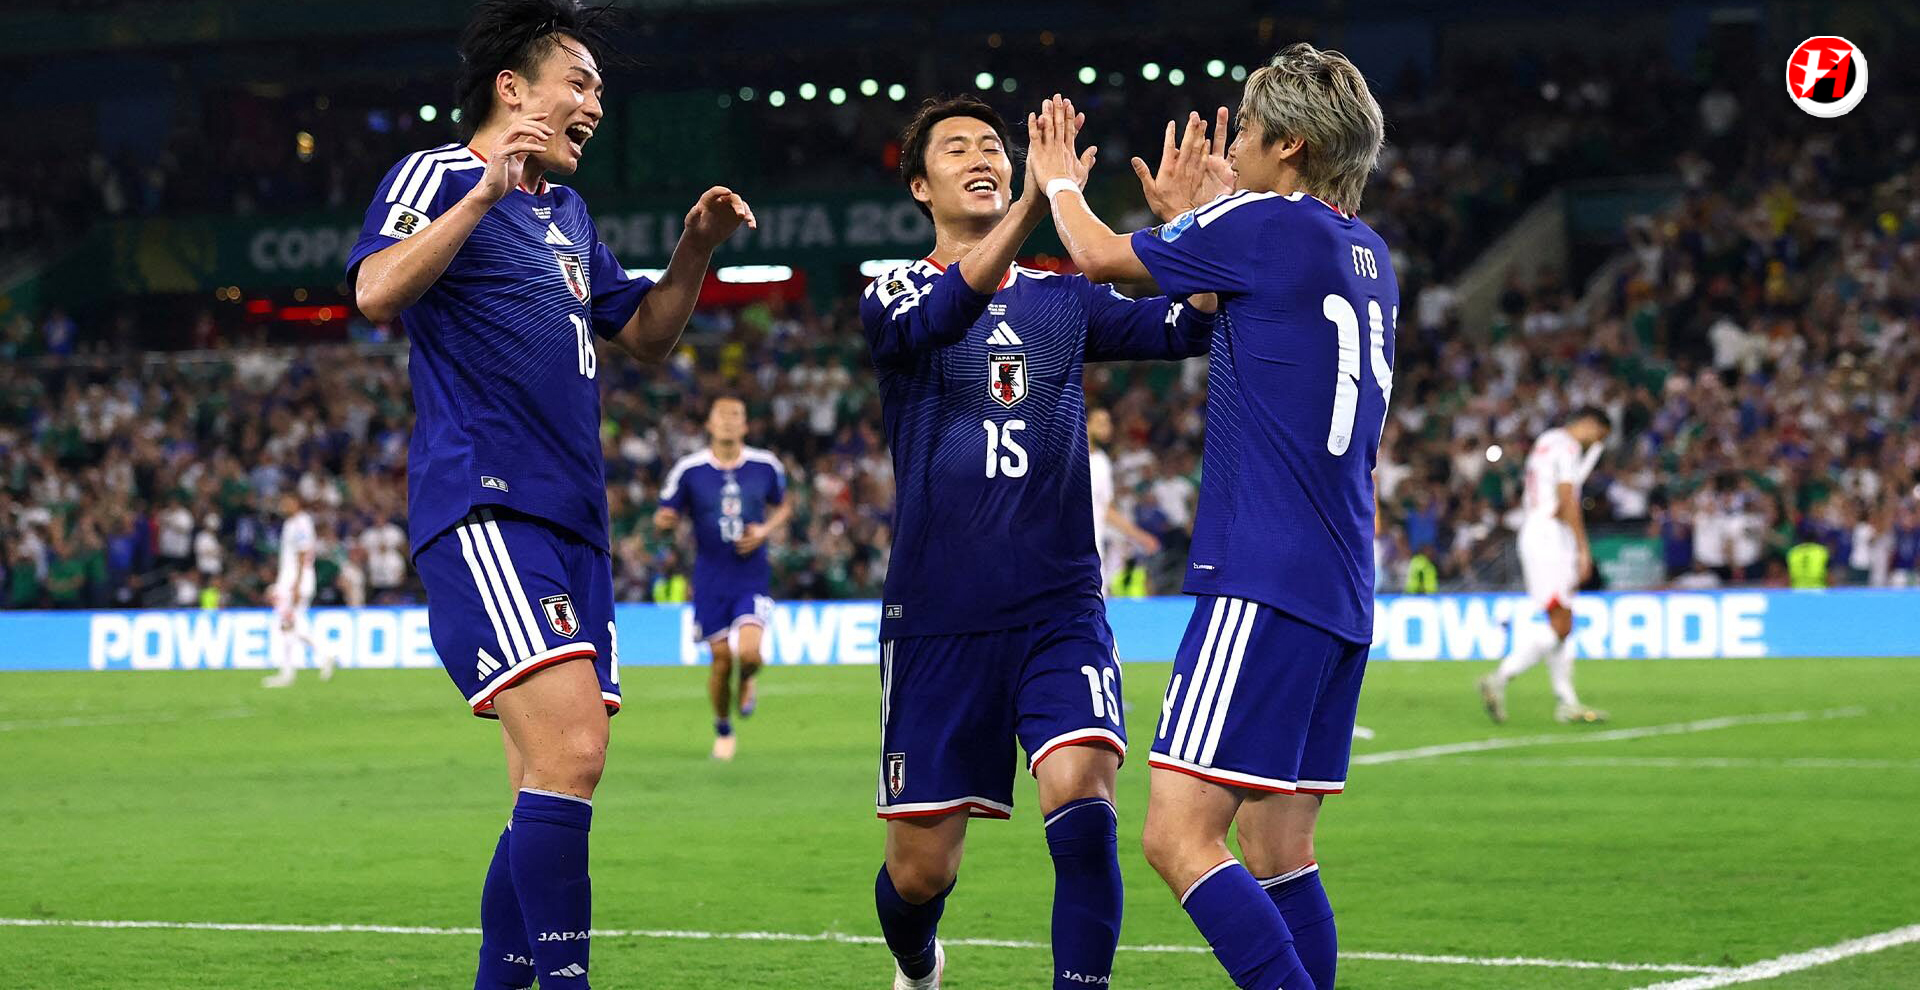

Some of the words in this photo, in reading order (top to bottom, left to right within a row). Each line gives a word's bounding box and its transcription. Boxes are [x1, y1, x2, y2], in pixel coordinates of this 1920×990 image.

[1351, 244, 1378, 280] ITO
[983, 419, 1029, 479] 15
[1081, 665, 1120, 727] 15
[1062, 969, 1111, 984] JAPA
